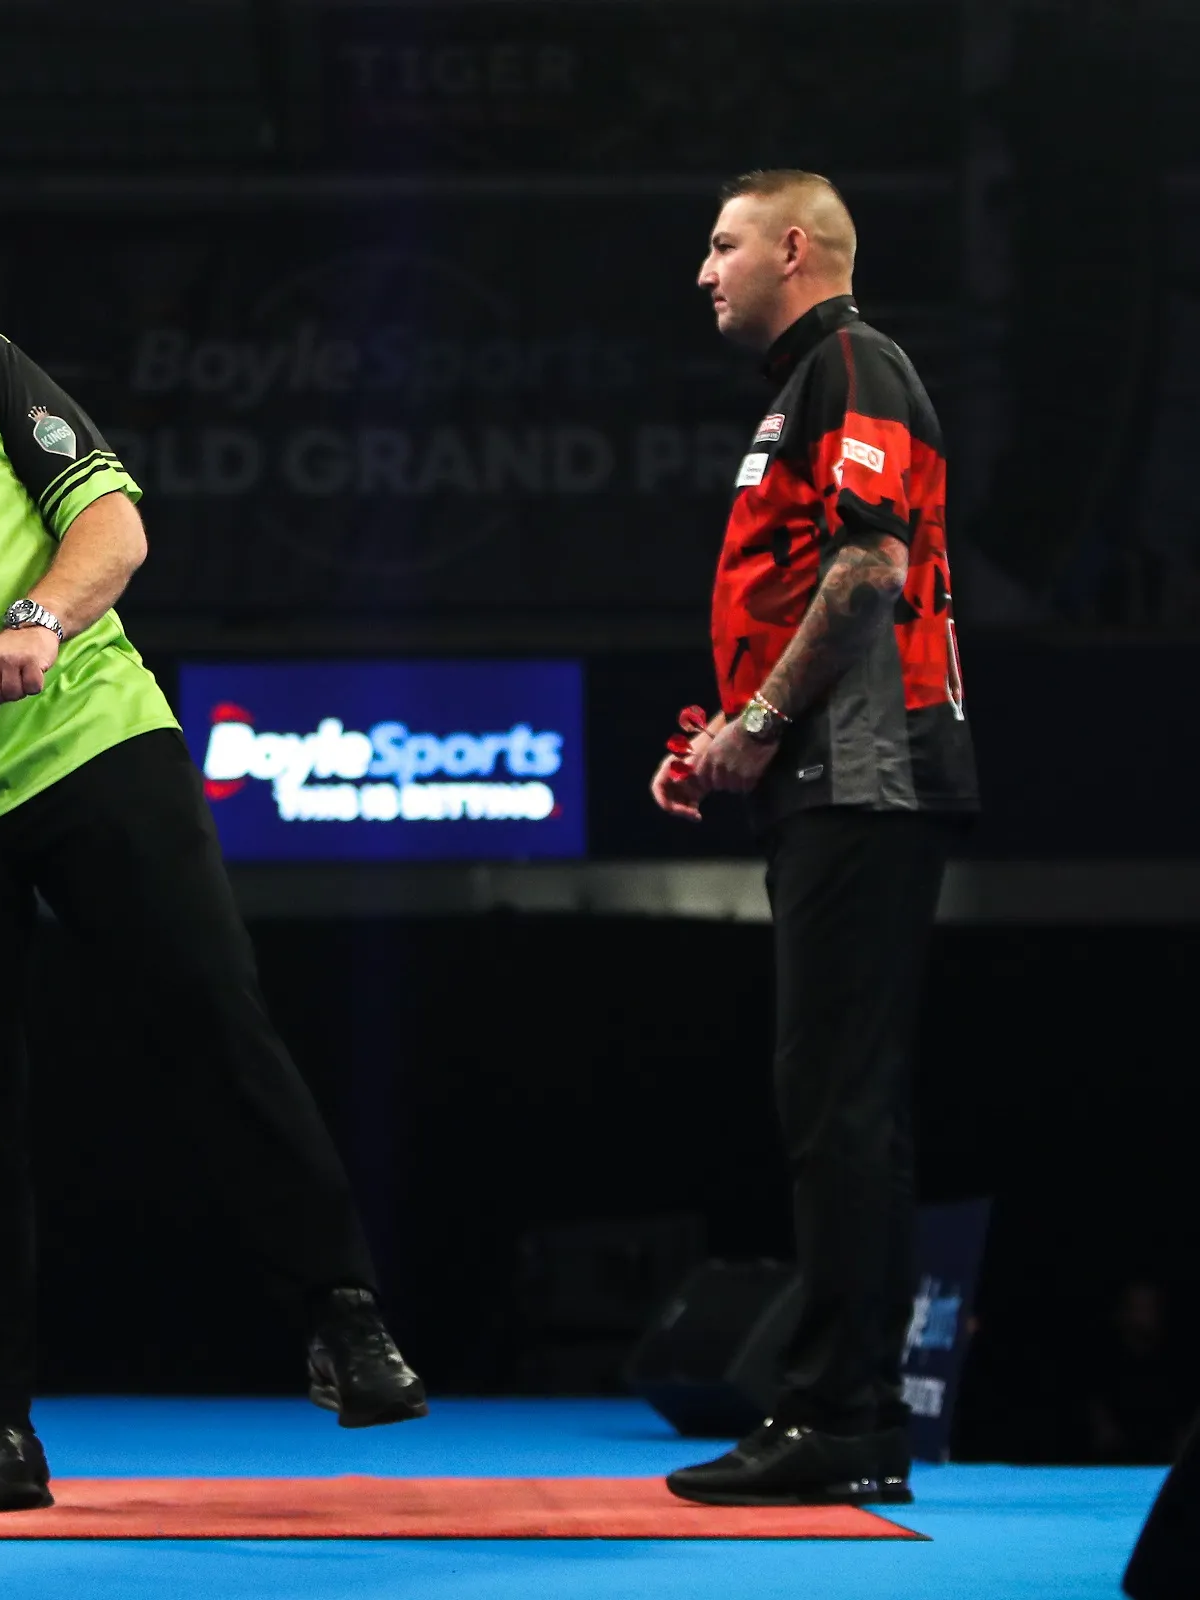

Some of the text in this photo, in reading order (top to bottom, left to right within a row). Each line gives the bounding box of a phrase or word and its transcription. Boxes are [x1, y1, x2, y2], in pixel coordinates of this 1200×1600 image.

[339, 44, 575, 94] TIGER
[131, 320, 640, 408] BoyleSports
[41, 425, 72, 448] KINGS
[104, 424, 724, 497] RLD GRAND PR
[204, 717, 564, 799] BoyleSports
